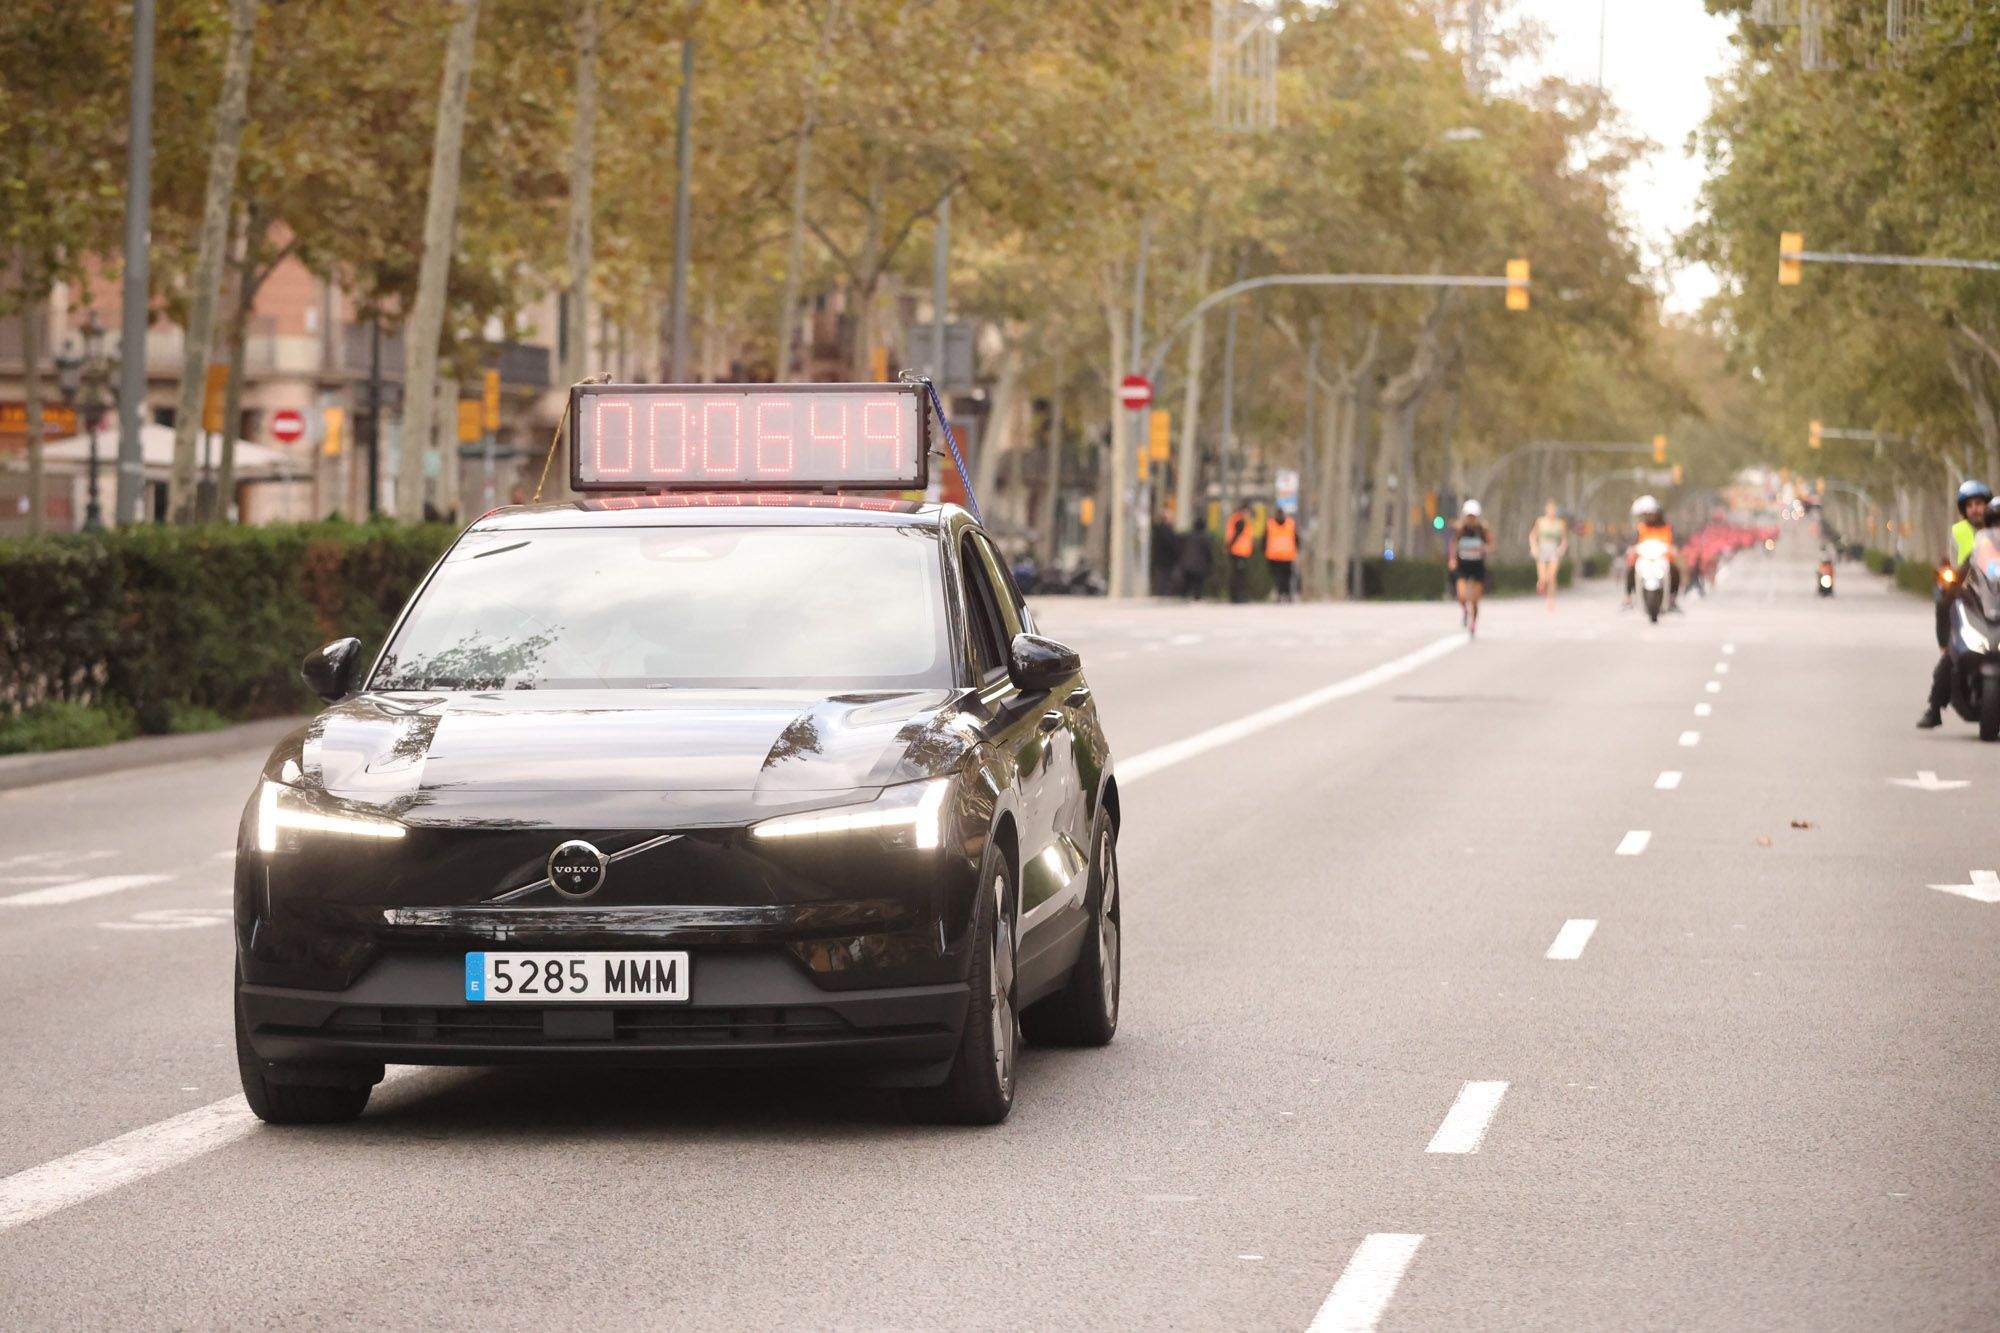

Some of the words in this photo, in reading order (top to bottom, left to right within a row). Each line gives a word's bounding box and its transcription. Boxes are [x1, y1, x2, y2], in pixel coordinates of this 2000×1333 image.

[471, 982, 479, 991] E
[494, 960, 588, 994] 5285
[605, 960, 676, 993] MMM
